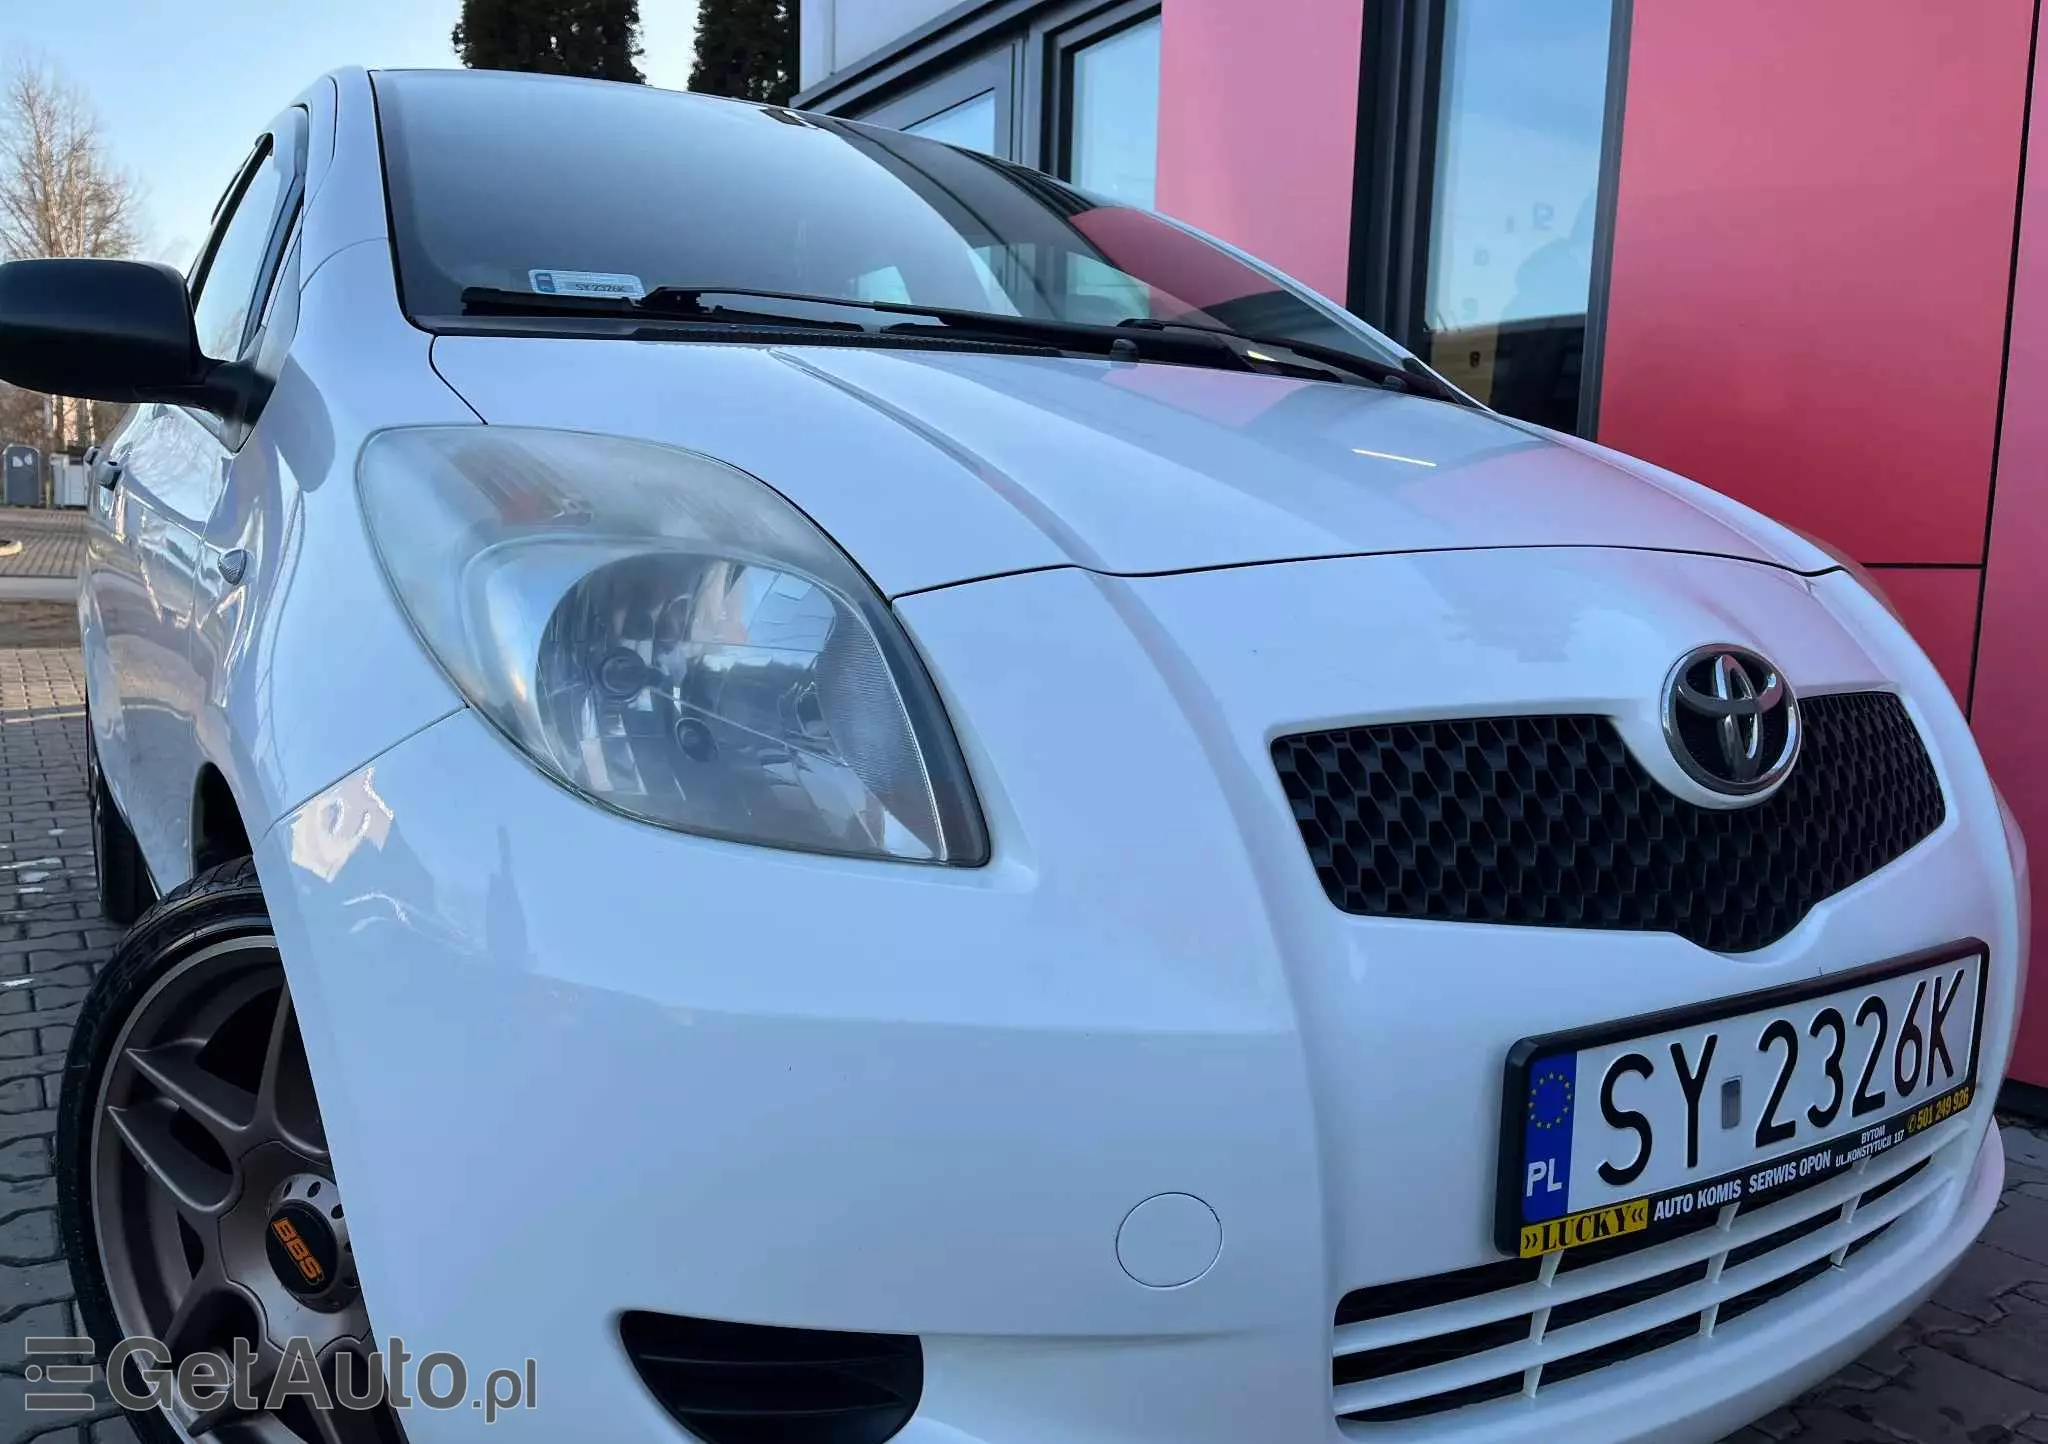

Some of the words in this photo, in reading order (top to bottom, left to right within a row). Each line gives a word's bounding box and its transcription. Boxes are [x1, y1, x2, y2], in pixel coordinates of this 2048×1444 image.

[1597, 1034, 1717, 1186] SY
[1755, 969, 1964, 1147] 2326K
[1861, 1125, 1886, 1144] BYTOM
[1917, 1104, 1933, 1130] 501
[1935, 1096, 1951, 1120] 249
[1952, 1087, 1970, 1111] 926
[1526, 1158, 1562, 1197] PL
[1653, 1194, 1693, 1222] AUTO
[1697, 1180, 1742, 1210] KOMIS
[1749, 1161, 1797, 1194] SERWIS
[1799, 1149, 1832, 1177] OPON
[271, 1217, 323, 1281] BBS
